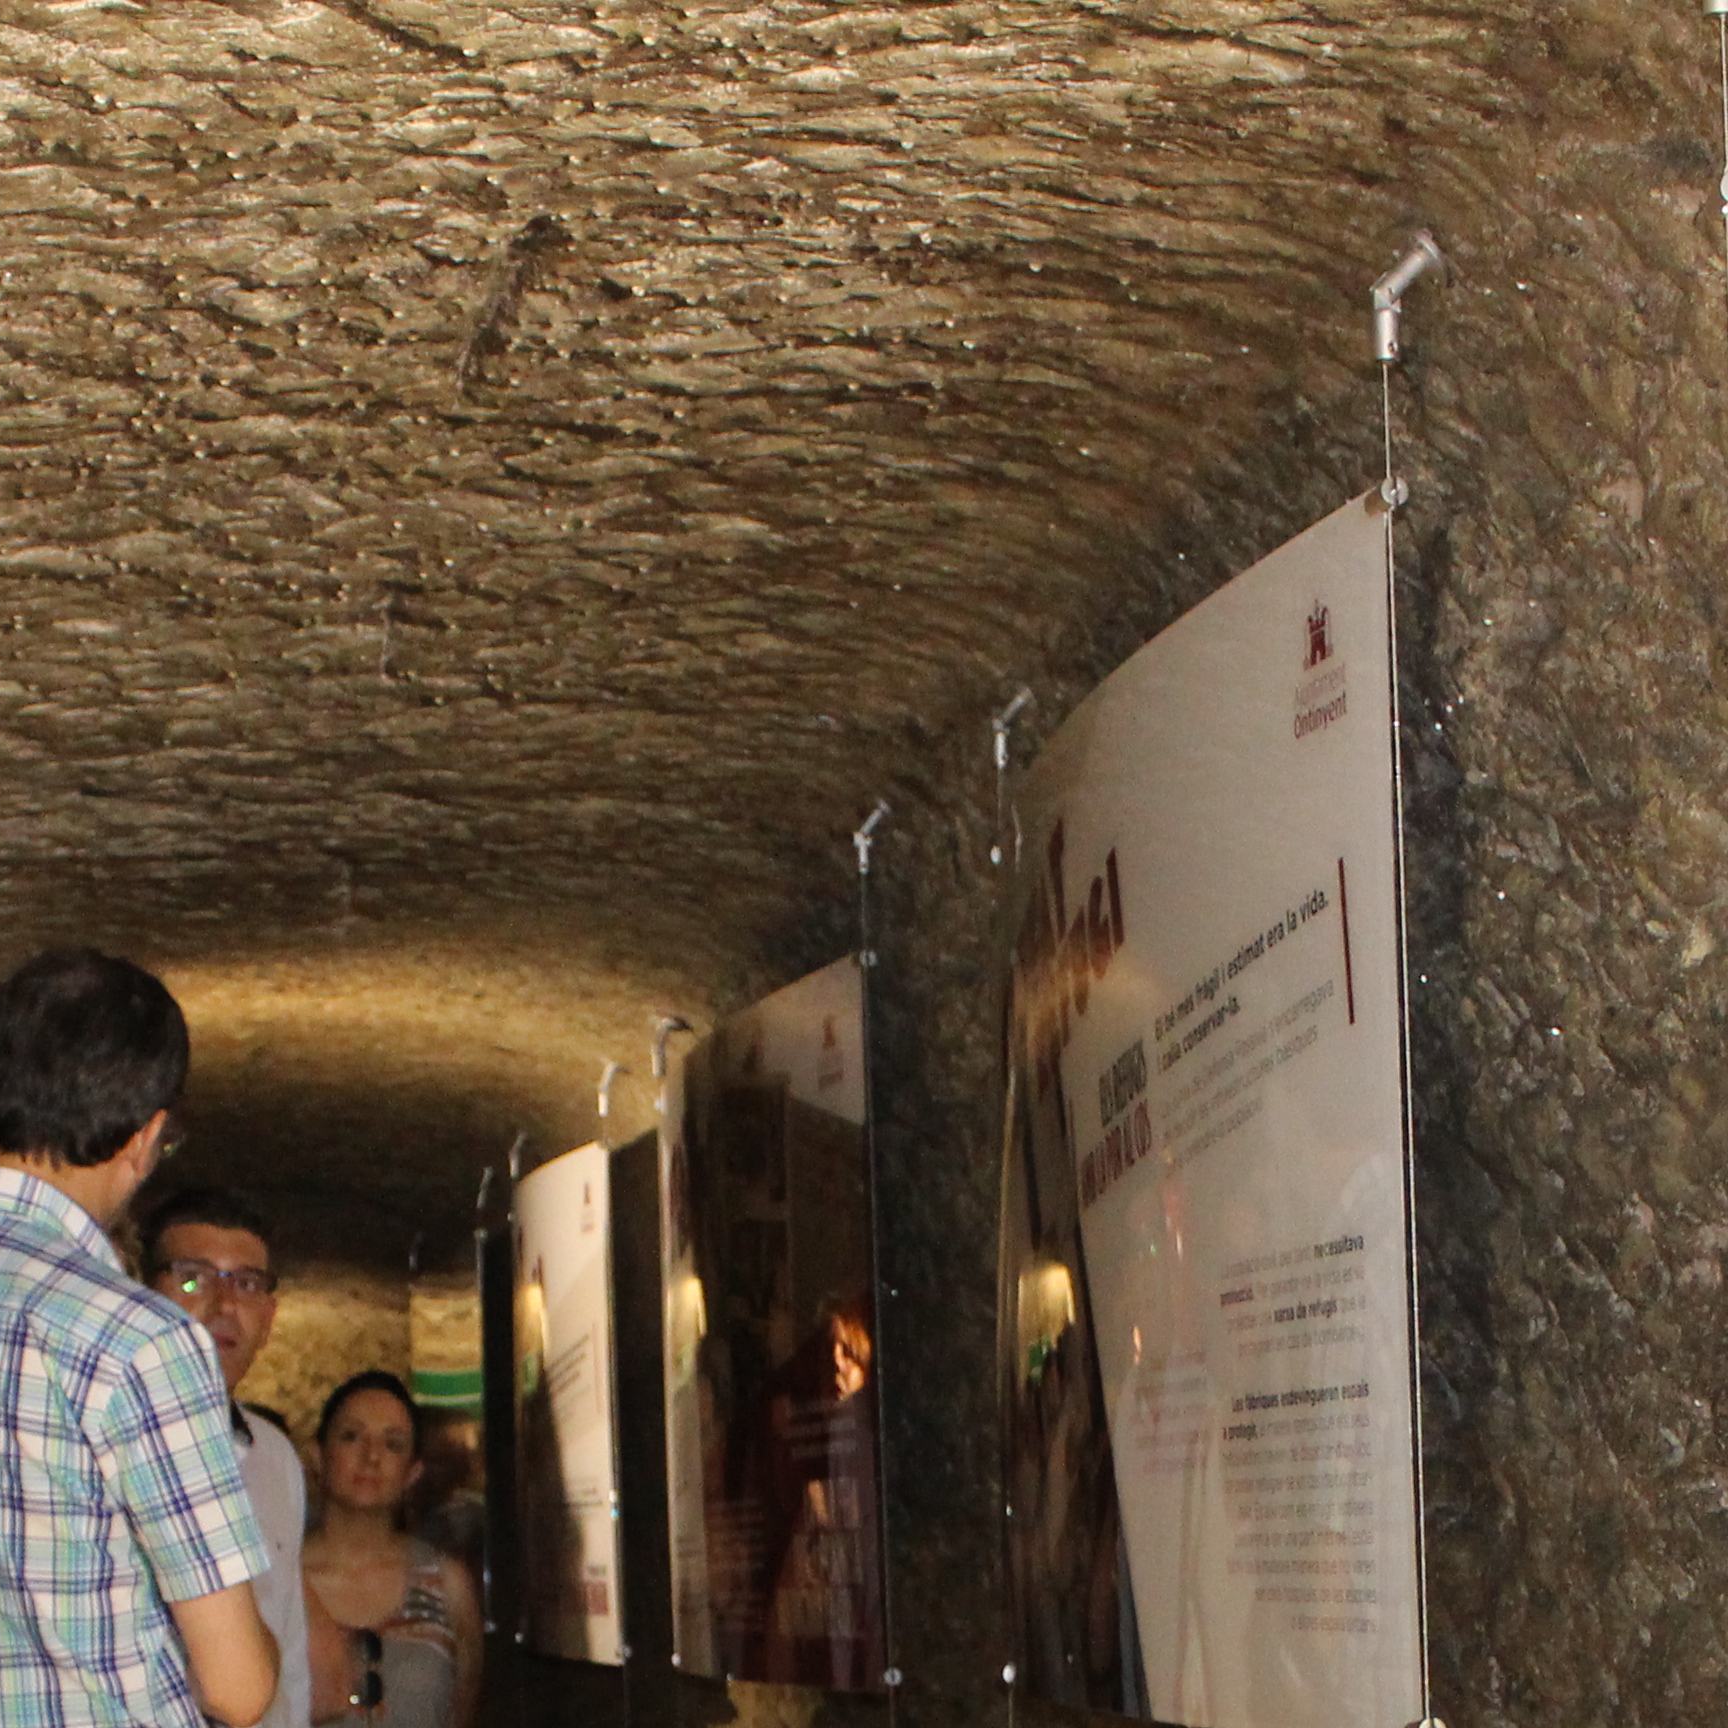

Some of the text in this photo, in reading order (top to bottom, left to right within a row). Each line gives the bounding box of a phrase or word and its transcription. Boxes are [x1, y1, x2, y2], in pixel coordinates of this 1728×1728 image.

[1294, 688, 1347, 740] Ontinyent
[1266, 922, 1284, 948] era
[1285, 909, 1297, 934] la
[1299, 889, 1329, 922] vida.
